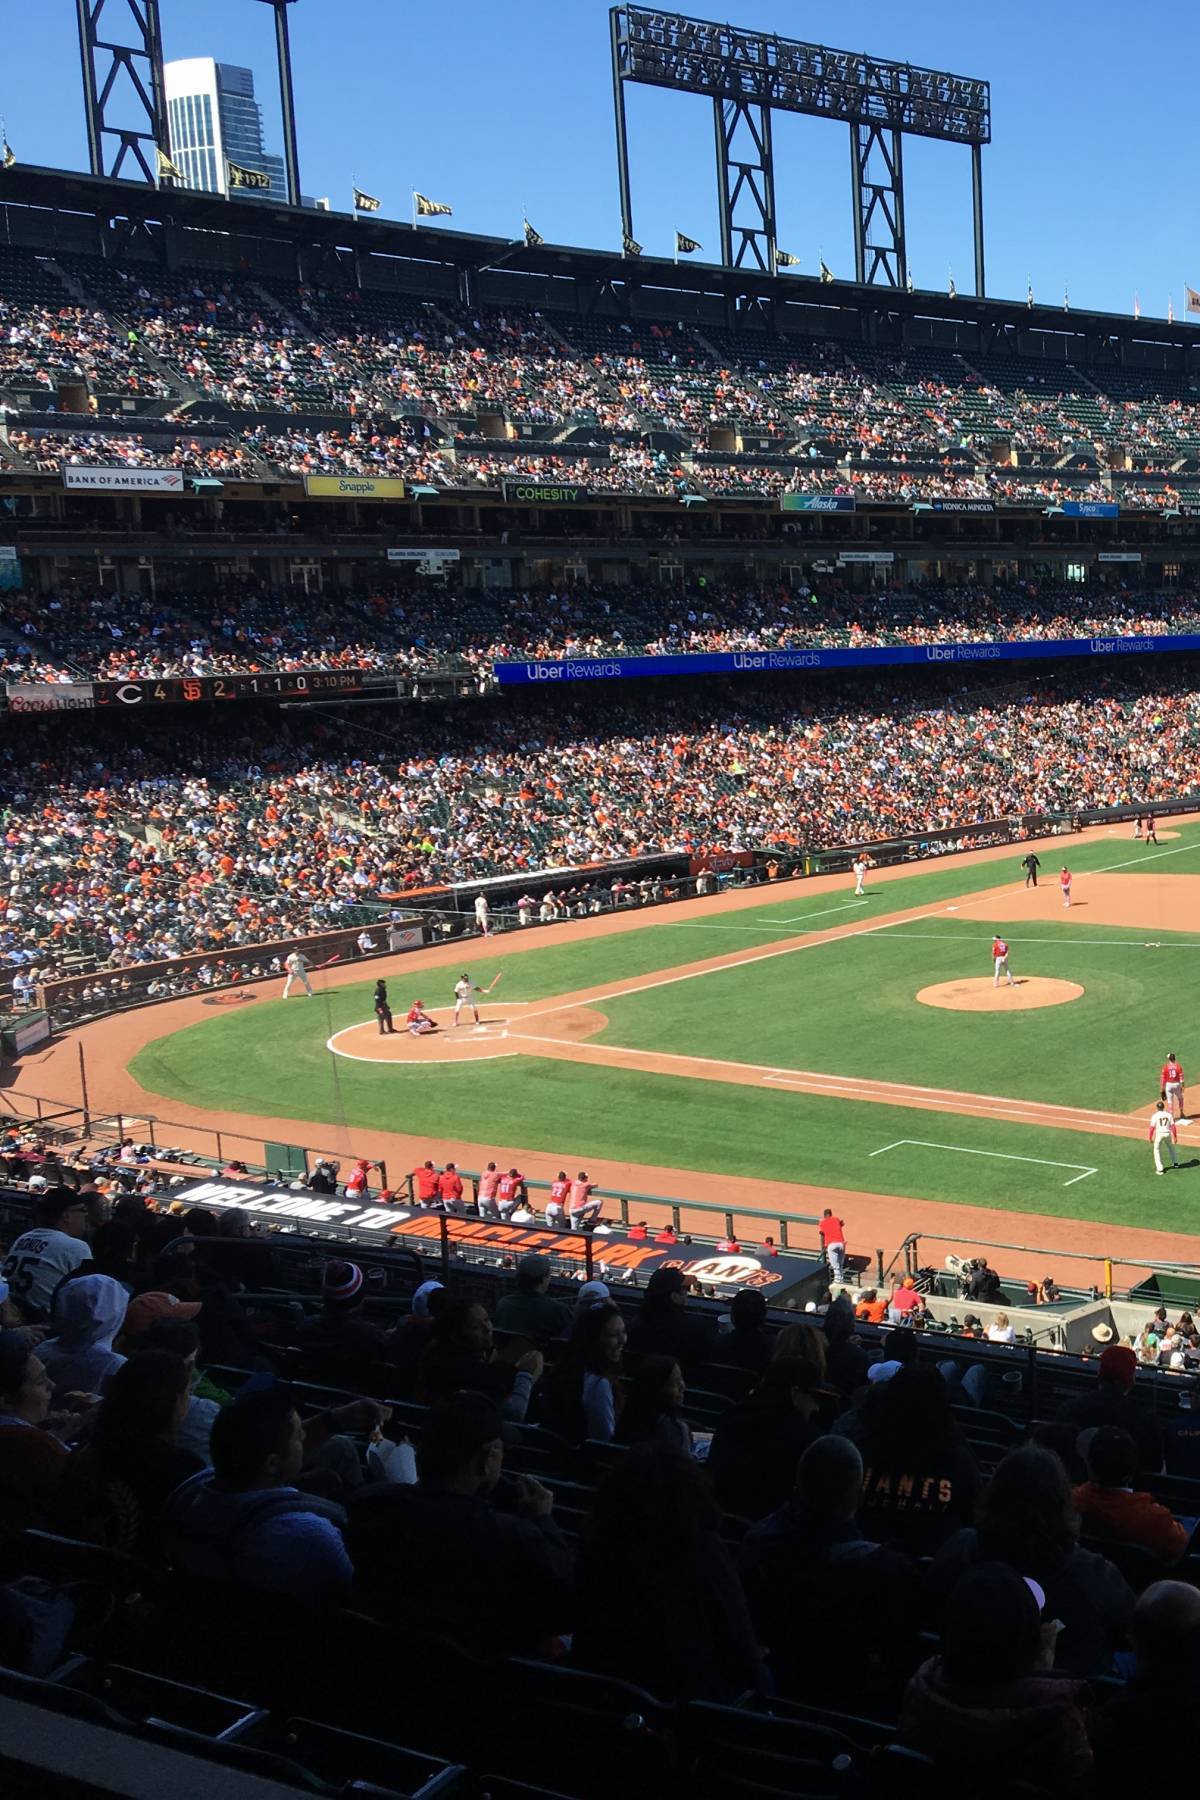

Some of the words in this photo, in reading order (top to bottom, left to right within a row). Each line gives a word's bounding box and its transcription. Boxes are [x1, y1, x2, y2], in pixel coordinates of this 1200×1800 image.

[245, 174, 268, 187] 1912
[68, 475, 96, 484] BANK
[99, 476, 112, 485] OF
[115, 477, 160, 486] AMERICA
[339, 480, 375, 494] Snapple
[516, 487, 578, 501] COHESITY
[803, 497, 838, 510] Alaska
[942, 502, 967, 511] KONICA
[967, 503, 994, 512] MINOLTA
[927, 646, 955, 660] Uber
[957, 644, 1001, 659] Rewards
[1090, 640, 1115, 653] Uber
[1116, 638, 1155, 652] Rewards
[733, 653, 766, 669] Uber
[769, 651, 821, 667] Rewards
[527, 664, 563, 680] Uber
[566, 661, 621, 678] Rewards
[214, 681, 226, 697] 2
[296, 677, 306, 689] 0
[313, 677, 337, 688] 3:10
[340, 676, 356, 687] PM
[154, 684, 166, 700] 4
[1160, 1117, 1169, 1127] 17
[177, 1182, 345, 1222] WELCOME
[342, 1204, 411, 1230] TO
[11, 1238, 48, 1254] BONDS
[390, 1215, 559, 1255] ORACLE
[550, 1233, 668, 1269] PARK
[659, 1258, 783, 1288] GIANTS
[863, 1467, 953, 1503] IANTS
